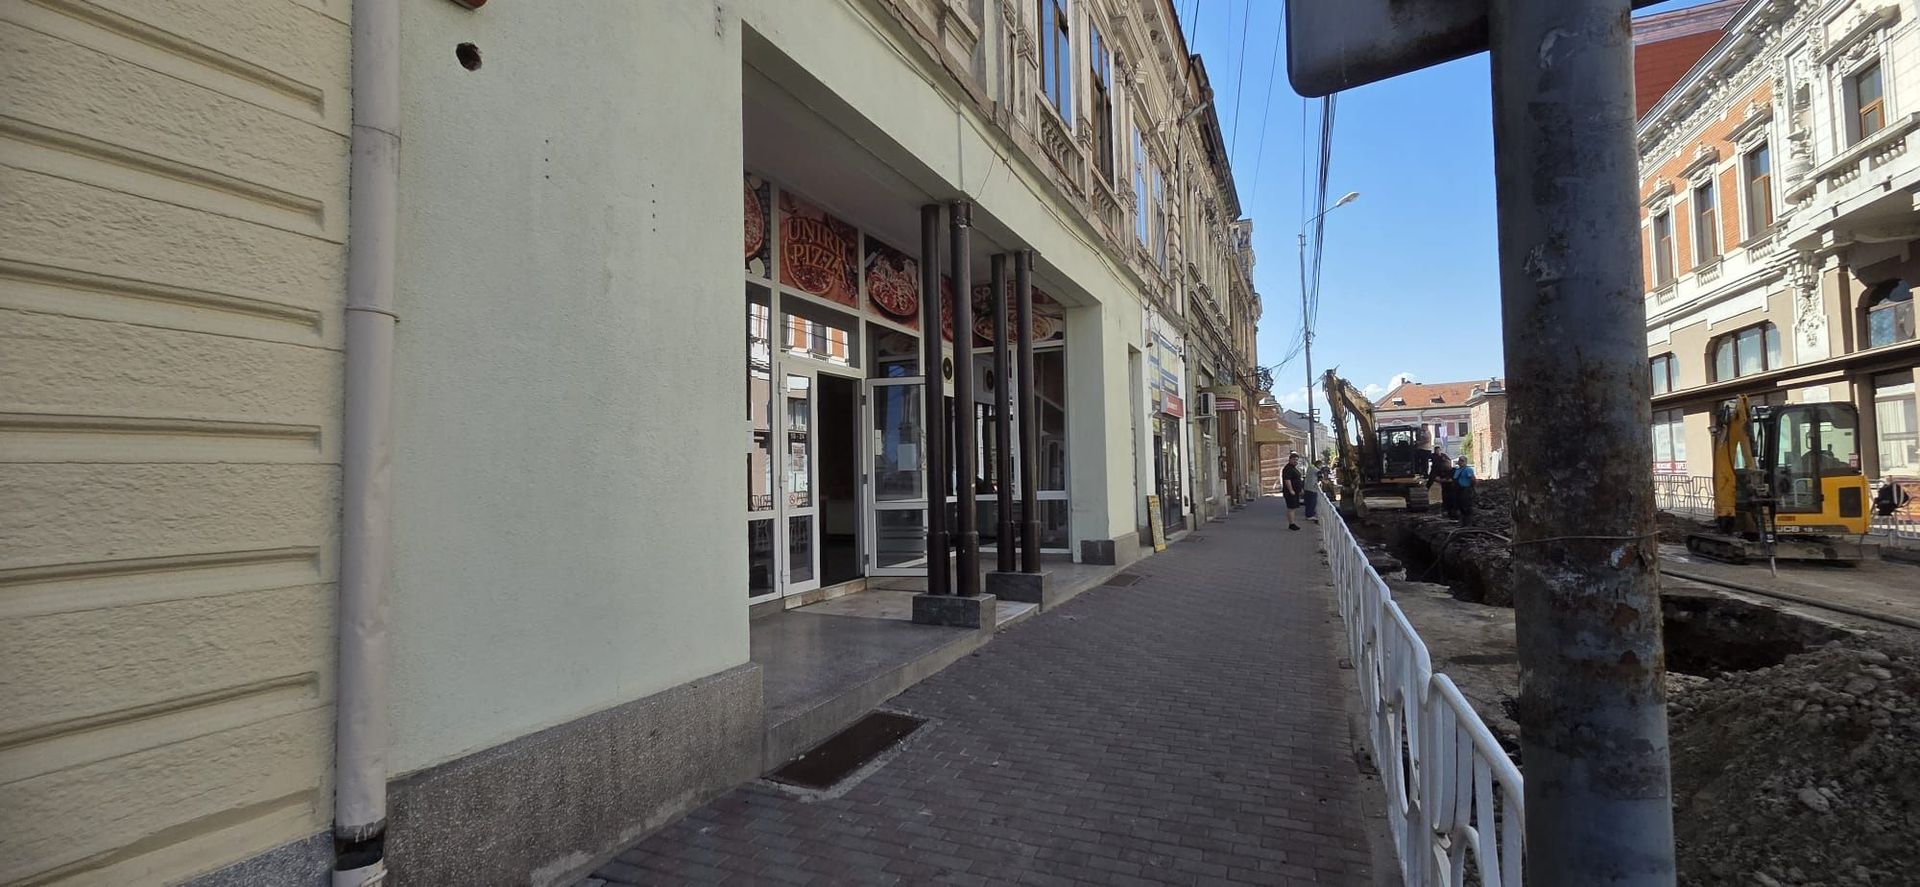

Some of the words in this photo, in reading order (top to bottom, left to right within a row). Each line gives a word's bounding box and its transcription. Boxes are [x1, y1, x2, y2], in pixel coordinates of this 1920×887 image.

[788, 217, 846, 261] UNIRII
[792, 243, 848, 287] PIZZA
[1775, 525, 1800, 533] JCB
